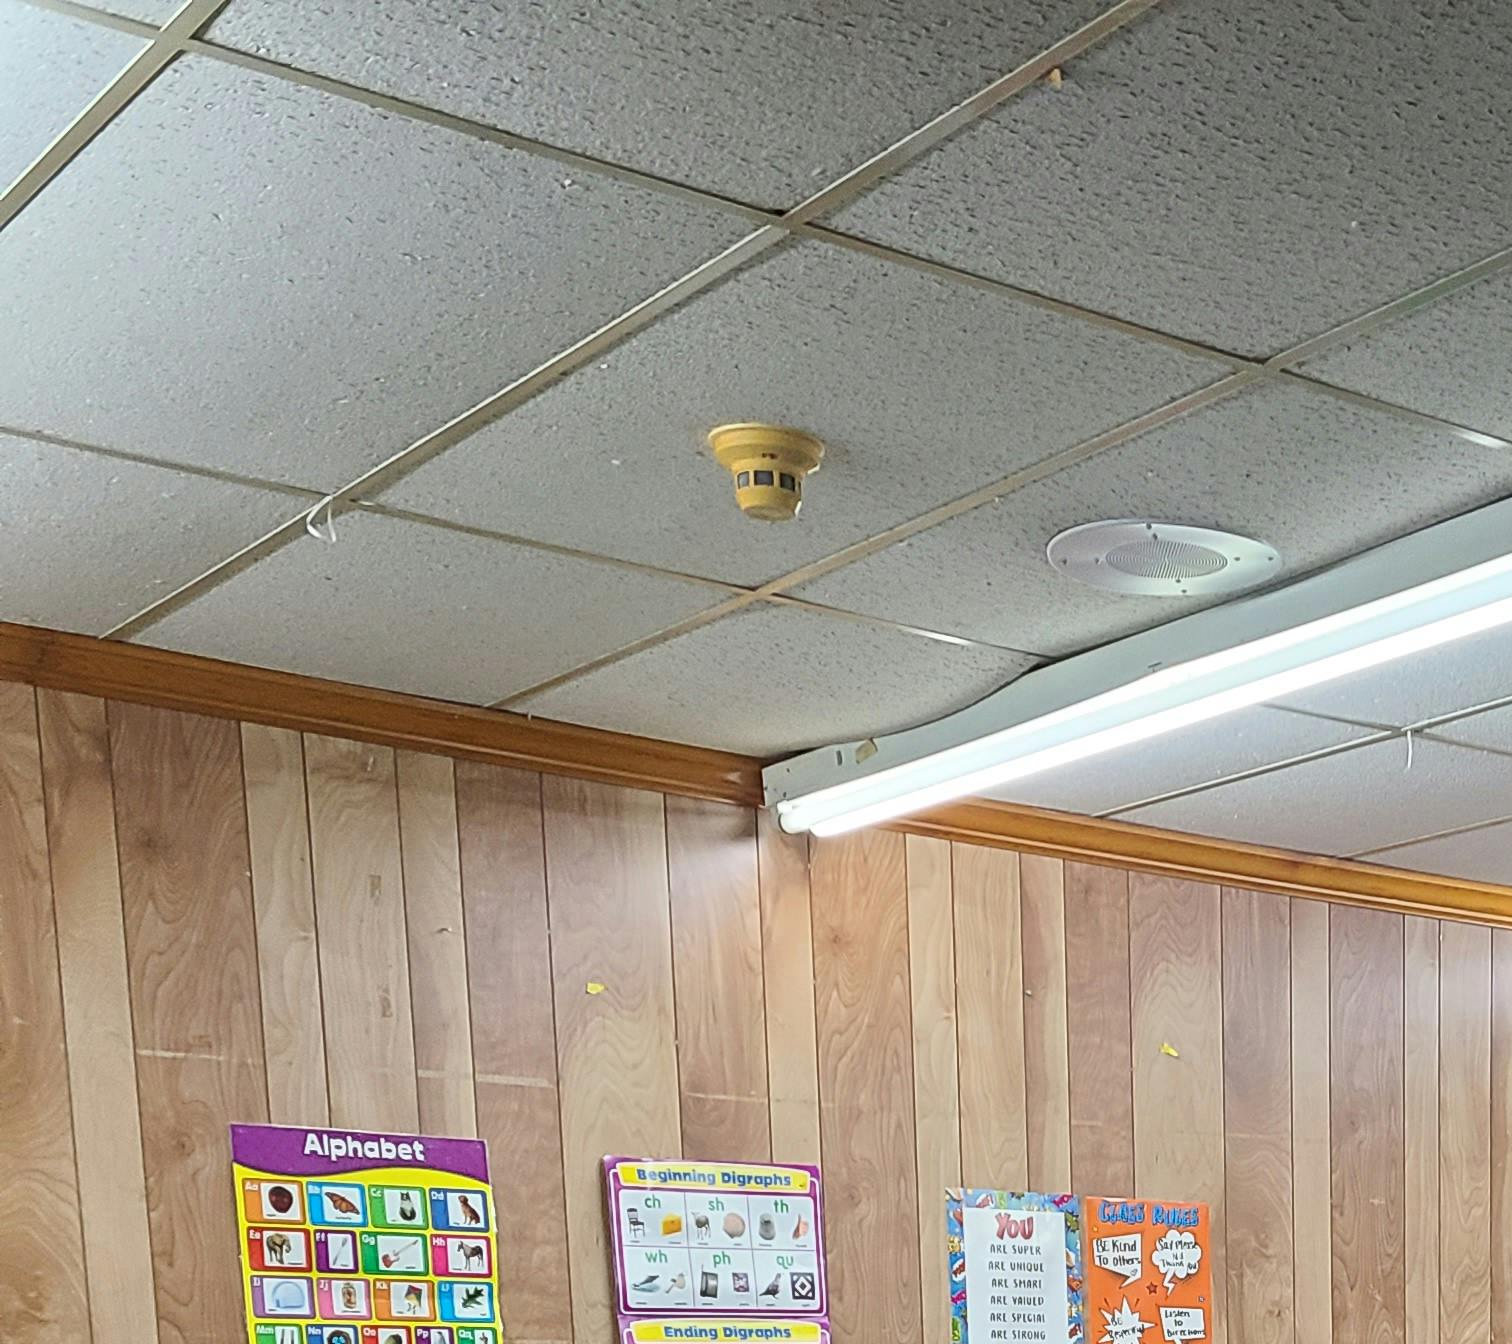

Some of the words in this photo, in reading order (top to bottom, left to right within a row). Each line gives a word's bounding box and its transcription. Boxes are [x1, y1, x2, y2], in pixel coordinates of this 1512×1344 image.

[304, 1133, 424, 1161] Alphabet
[636, 1168, 716, 1185] Beginning
[721, 1172, 791, 1188] Digraphs
[431, 1190, 444, 1200] Dd
[644, 1195, 661, 1209] ch
[708, 1197, 725, 1212] sh
[774, 1200, 789, 1213] th
[994, 1212, 1034, 1240] YOU
[250, 1230, 260, 1240] Ee
[362, 1235, 376, 1245] Gg
[433, 1237, 446, 1246] Hh
[990, 1244, 1007, 1254] ARE
[1012, 1245, 1041, 1255] SUPER
[645, 1250, 668, 1264] wh
[713, 1252, 731, 1268] ph
[776, 1255, 794, 1269] qu
[988, 1261, 1005, 1271] ARE
[1010, 1262, 1044, 1272] UNIQUE
[320, 1280, 329, 1290] Jj
[376, 1281, 388, 1290] Kk
[992, 1278, 1008, 1288] ARE
[1013, 1279, 1042, 1289] SMART
[991, 1296, 1007, 1305] ARE
[1012, 1296, 1044, 1306] VALUED
[990, 1313, 1007, 1322] ARE
[1012, 1313, 1045, 1323] SPECIAL
[256, 1325, 273, 1334] Mm
[308, 1326, 321, 1335] Nn
[363, 1327, 376, 1337] Oo
[417, 1328, 429, 1338] Pp
[459, 1330, 473, 1339] Qq
[664, 1326, 718, 1339] Ending
[722, 1326, 791, 1340] Digraphs
[991, 1330, 1007, 1339] ARE
[1012, 1330, 1046, 1340] STRONG
